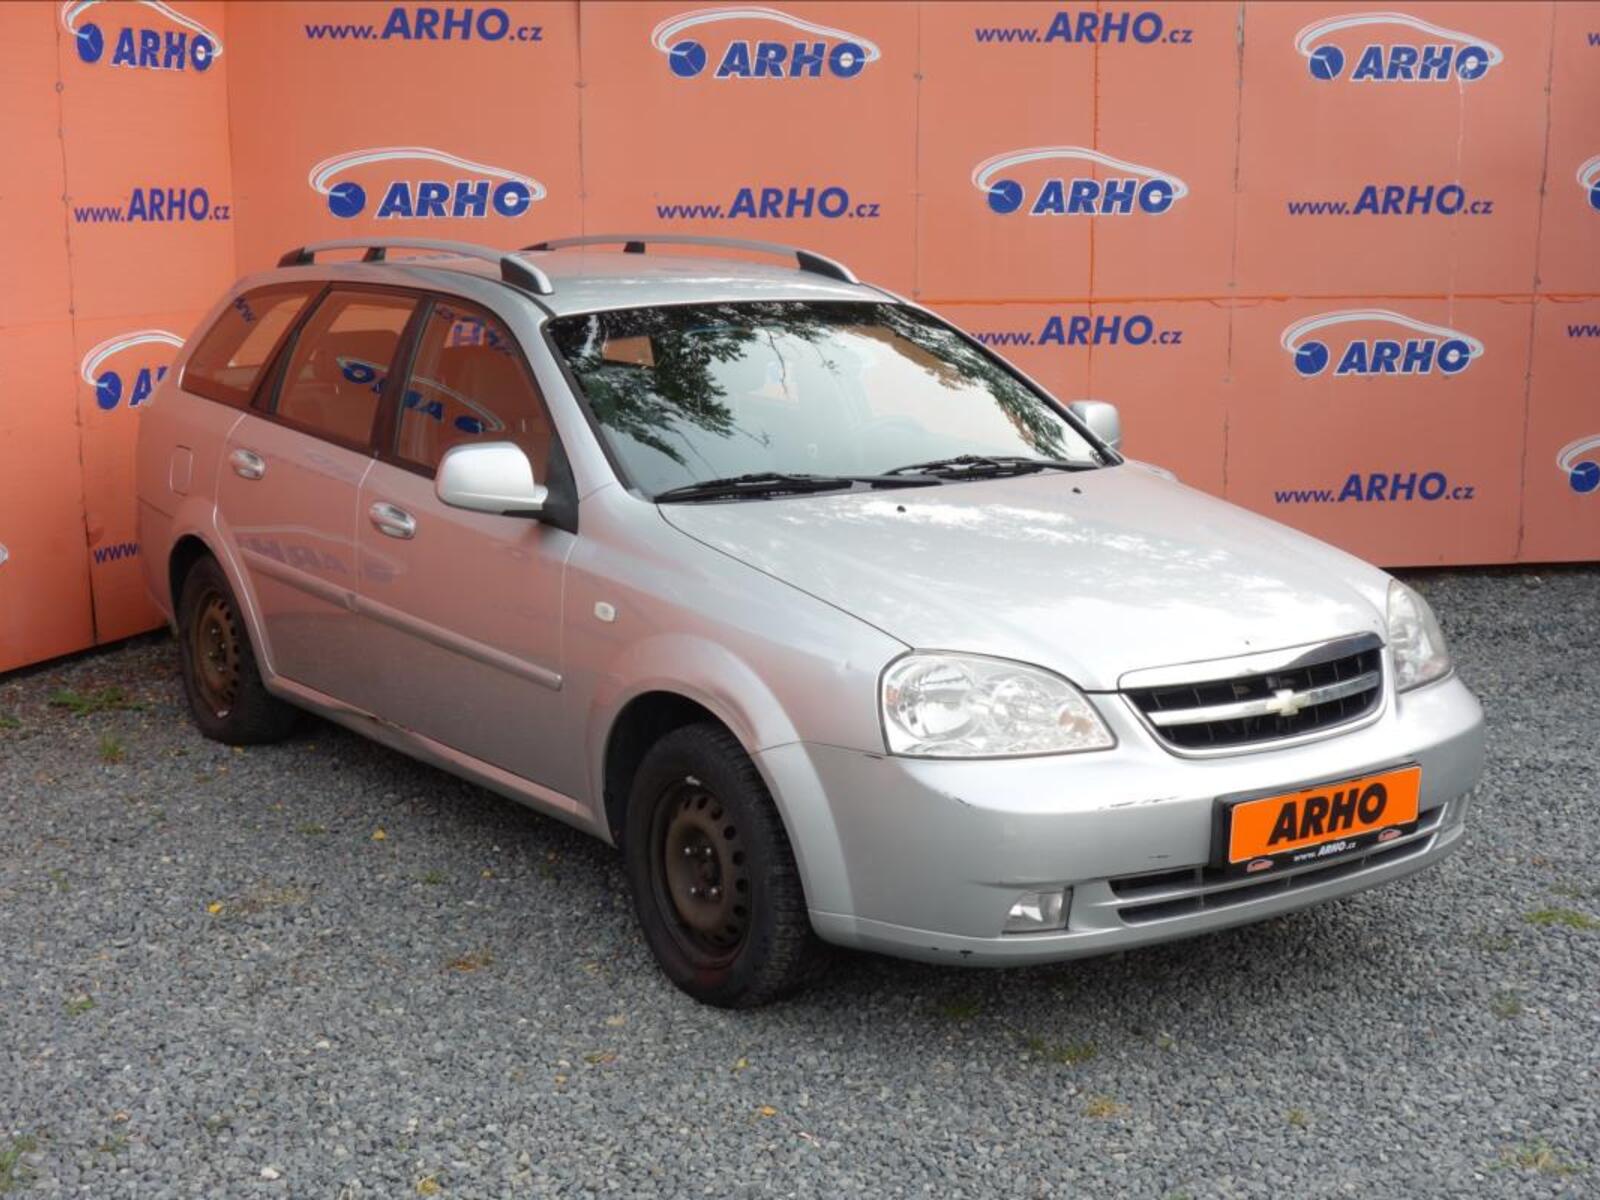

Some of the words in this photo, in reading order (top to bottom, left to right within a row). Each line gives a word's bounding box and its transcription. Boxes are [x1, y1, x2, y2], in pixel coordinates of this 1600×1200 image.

[305, 7, 544, 42] www.ARHO.cz
[975, 11, 1194, 45] www.ARHO.cz
[111, 27, 215, 72] ARHO
[715, 39, 867, 79] ARHO
[1350, 44, 1490, 82] ARHO
[74, 187, 231, 222] www.ARHO.cz
[376, 180, 532, 220] ARHO
[657, 187, 881, 220] www.ARHO.cz
[1030, 178, 1176, 217] ARHO
[1287, 184, 1494, 216] www.ARHO.cz
[1333, 339, 1471, 376] ARHO
[1274, 471, 1475, 504] www.ARHO.cz
[1267, 782, 1388, 846] ARHO
